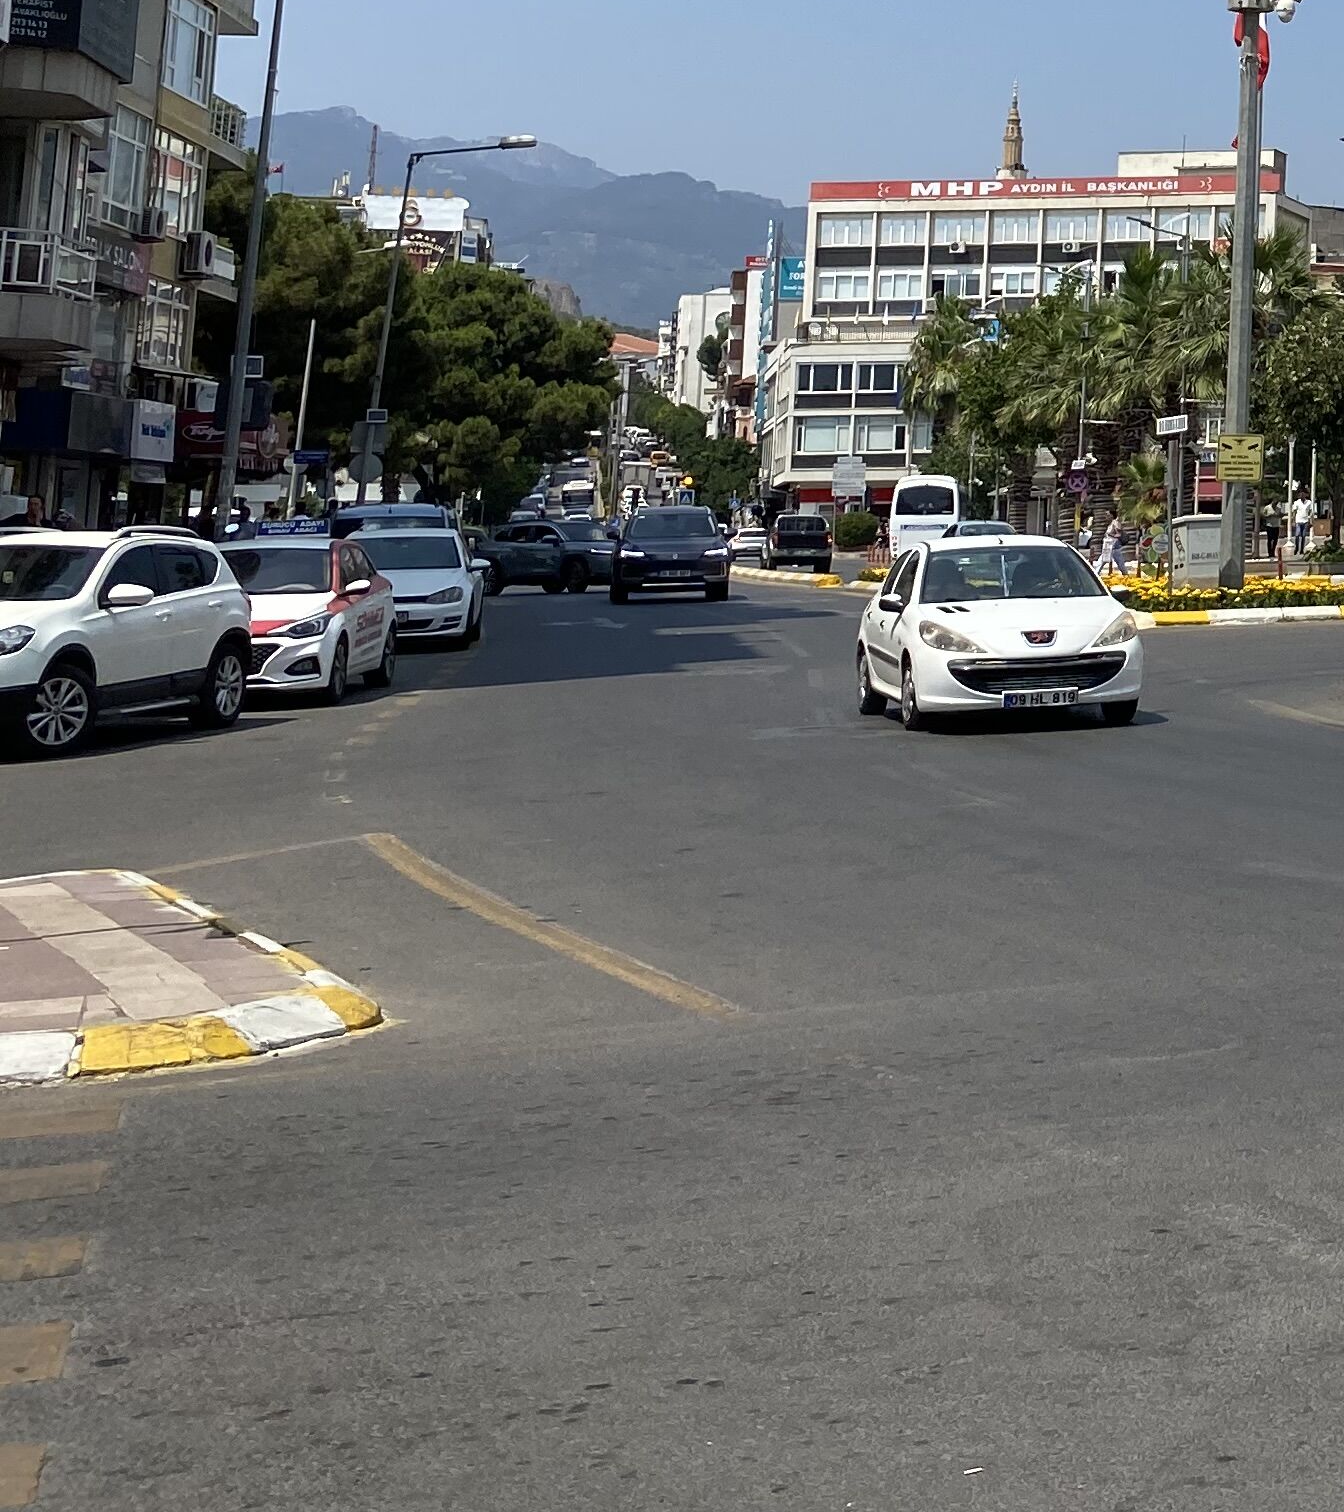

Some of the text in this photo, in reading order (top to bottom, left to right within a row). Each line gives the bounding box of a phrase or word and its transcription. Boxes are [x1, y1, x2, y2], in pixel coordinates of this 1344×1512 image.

[910, 179, 1179, 196] MHP AYDIN İL BAŞKANLIĞI
[1011, 693, 1027, 706] 09
[1052, 690, 1076, 704] 819
